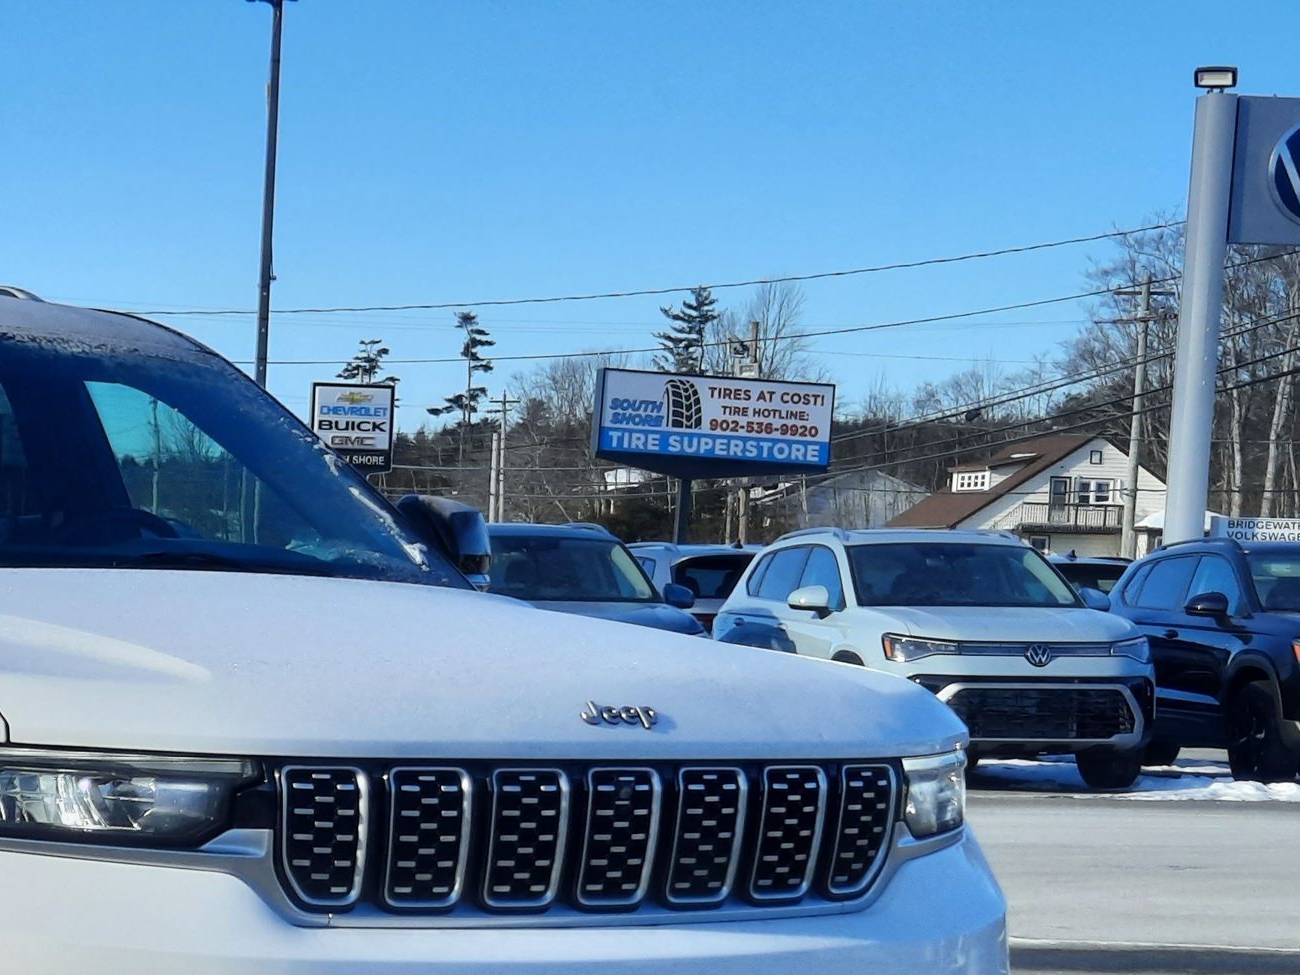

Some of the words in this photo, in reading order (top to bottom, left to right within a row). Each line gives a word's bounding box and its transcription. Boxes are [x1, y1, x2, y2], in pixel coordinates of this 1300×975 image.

[708, 386, 752, 401] TIRES
[756, 390, 776, 404] AT
[780, 391, 825, 407] COST!
[320, 405, 388, 417] CHEVROLET
[609, 397, 663, 413] SOUTH
[721, 405, 749, 417] TIRE
[753, 407, 810, 421] HOTLINE:
[318, 419, 387, 433] BUICK
[610, 412, 665, 428] SHORE
[709, 418, 819, 438] 902-536-9920
[331, 435, 376, 447] GMC
[608, 431, 660, 450] TIRE
[667, 435, 820, 462] SUPERSTORE
[352, 455, 385, 466] SHORE
[580, 700, 658, 730] Jeep
